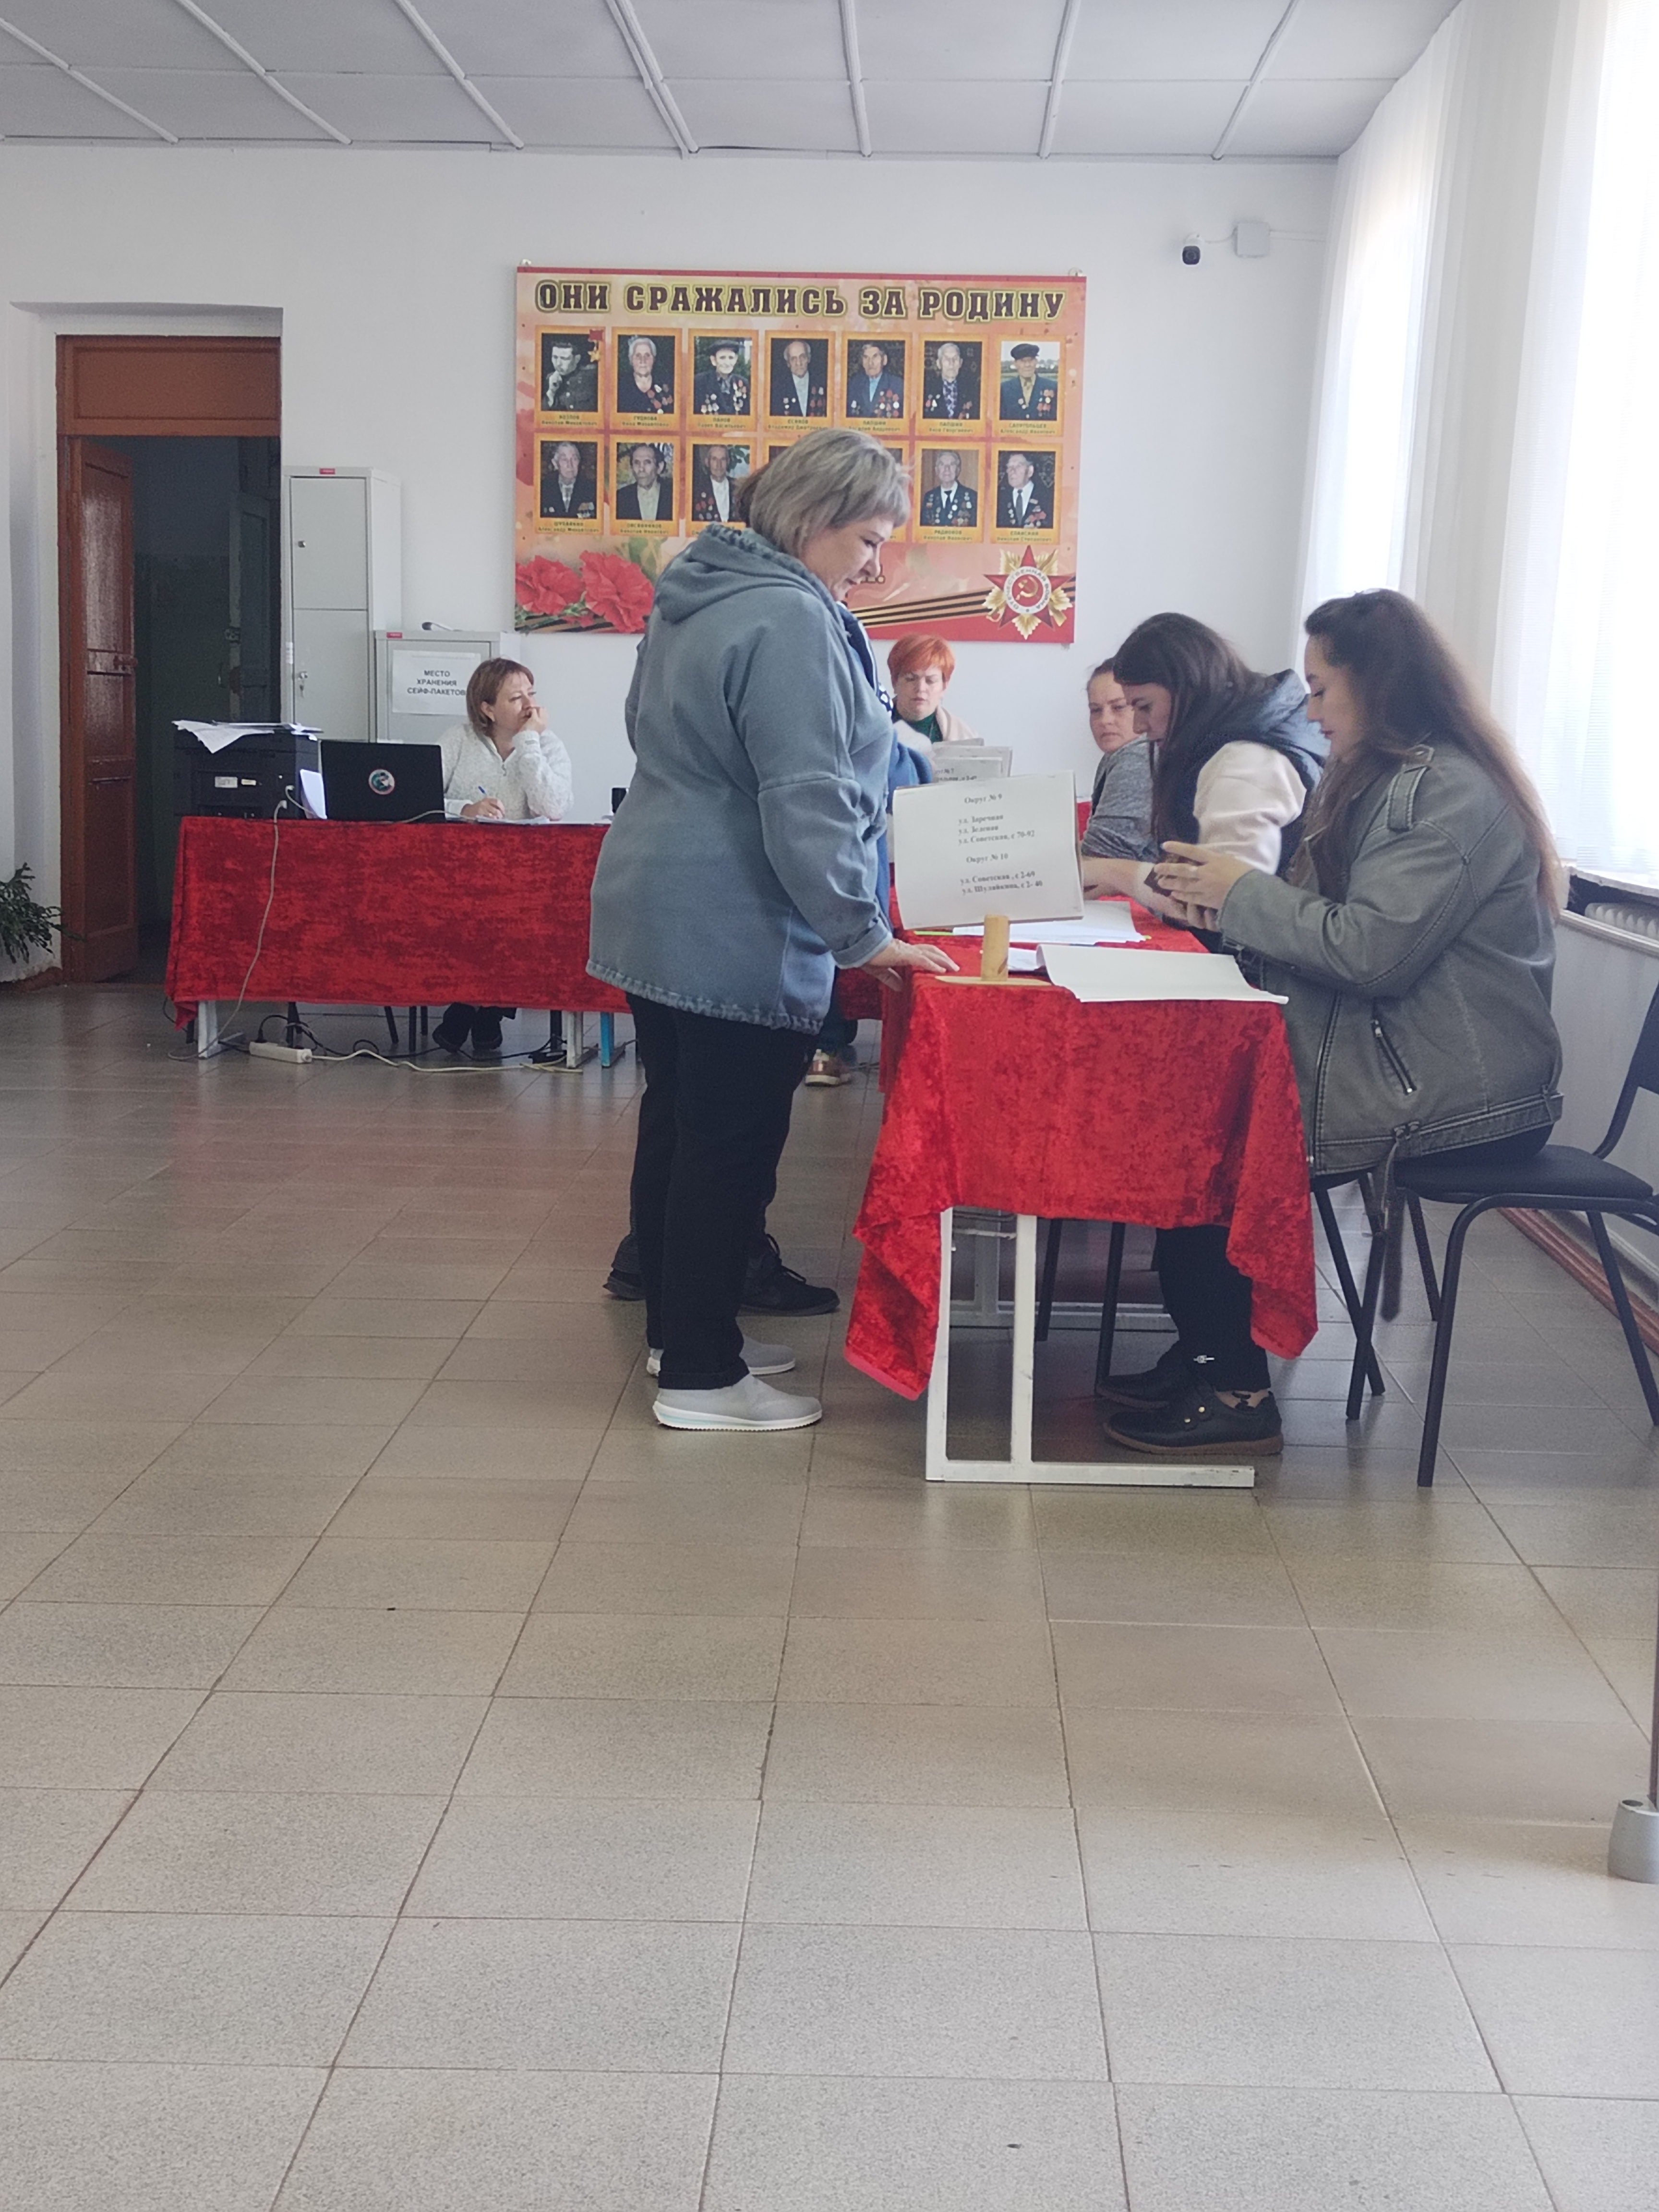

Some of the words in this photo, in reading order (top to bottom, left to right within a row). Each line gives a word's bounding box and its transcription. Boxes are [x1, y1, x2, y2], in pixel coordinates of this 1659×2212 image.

[537, 281, 610, 312] ОНИ
[625, 284, 847, 317] СРАЖАЛИСЬ
[859, 288, 907, 317] ЗА
[919, 289, 1065, 322] РОДИНУ
[417, 678, 457, 686] ХРАНЕНИЯ
[407, 687, 466, 696] СЕЙФ-ПАКЕТОВ
[958, 818, 969, 826] ул.
[971, 815, 1004, 824] Заречная
[958, 828, 969, 836] ул.
[958, 838, 969, 847] ул.
[970, 835, 1010, 843] Советская,
[966, 856, 988, 864] Округ
[960, 878, 971, 886] ул.
[962, 888, 973, 896] ул.
